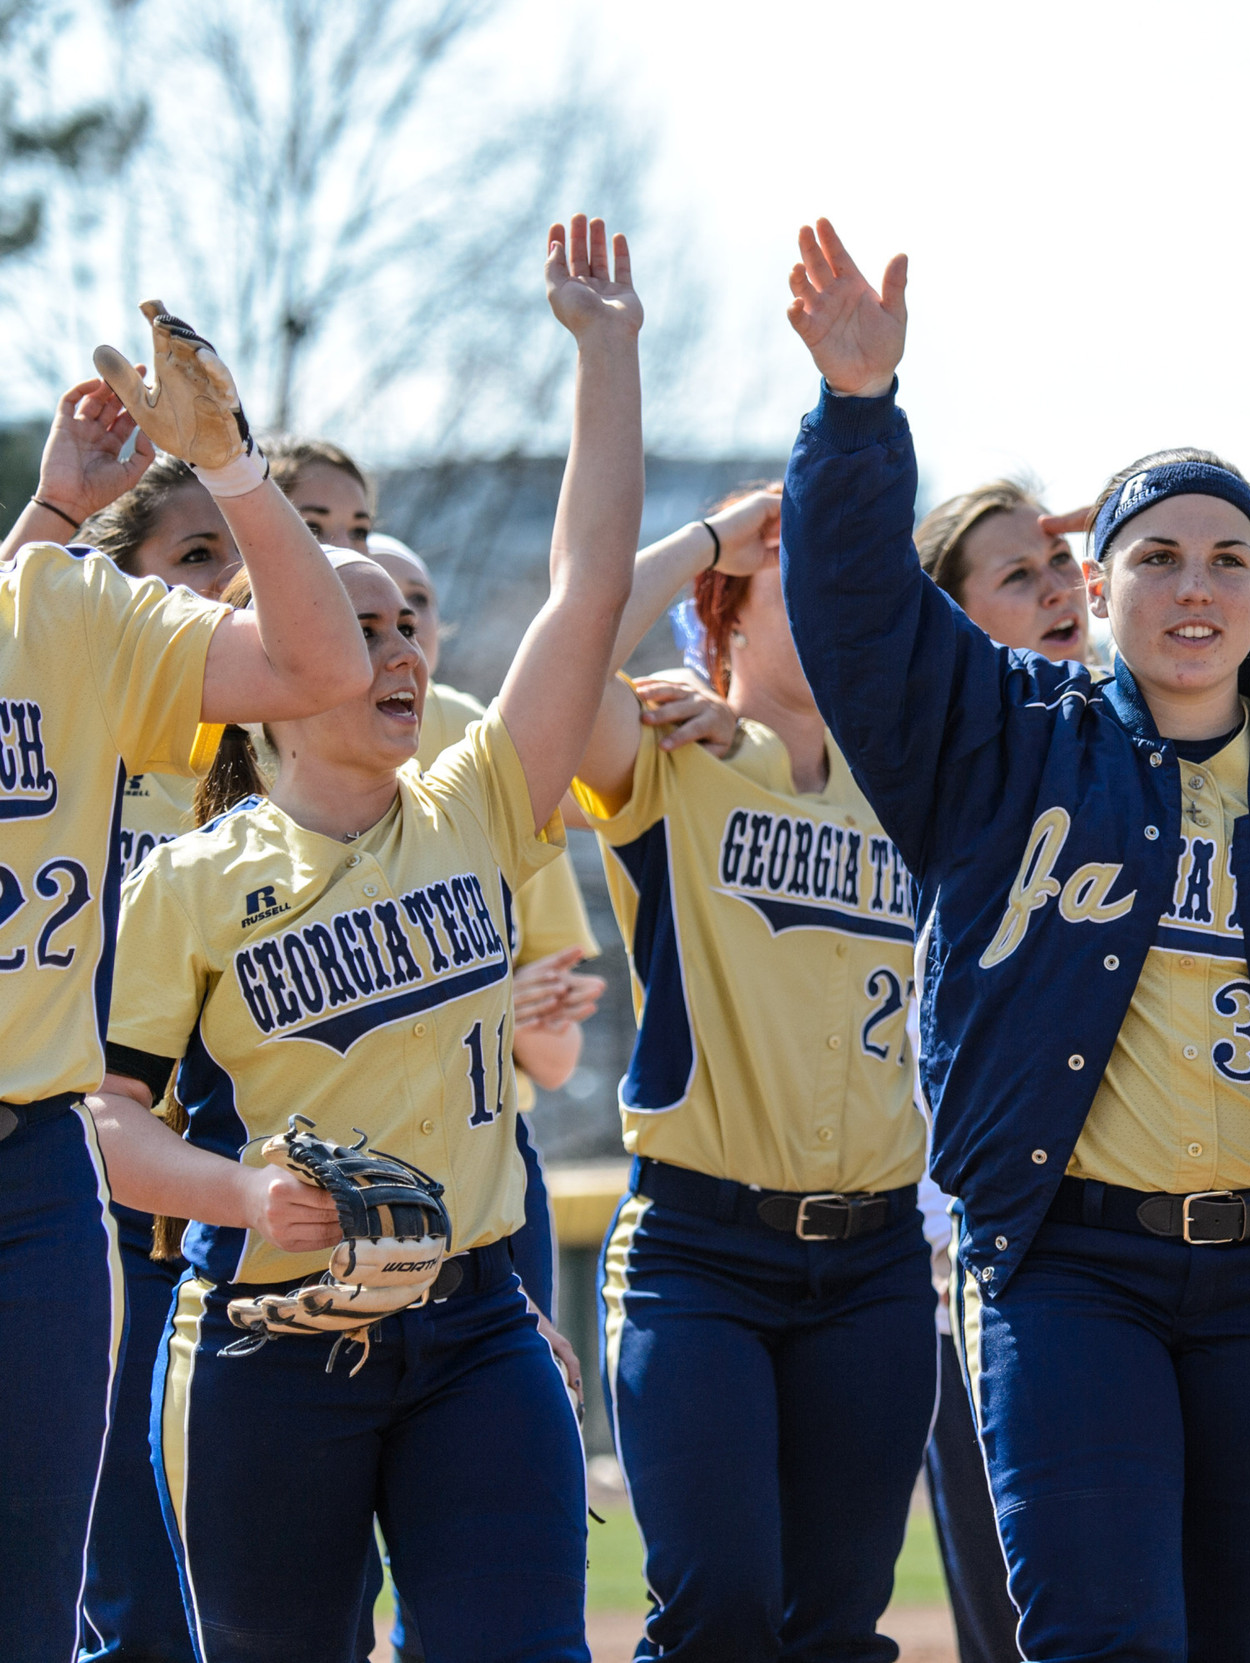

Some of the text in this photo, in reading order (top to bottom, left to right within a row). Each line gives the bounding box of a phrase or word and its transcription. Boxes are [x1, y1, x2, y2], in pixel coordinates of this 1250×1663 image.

[1114, 486, 1158, 519] RUSSELL
[720, 807, 863, 907] GEORGIA
[241, 902, 291, 928] RUSSELL
[234, 872, 504, 1034] GEORGIA TECH
[381, 1257, 439, 1273] WORTH
